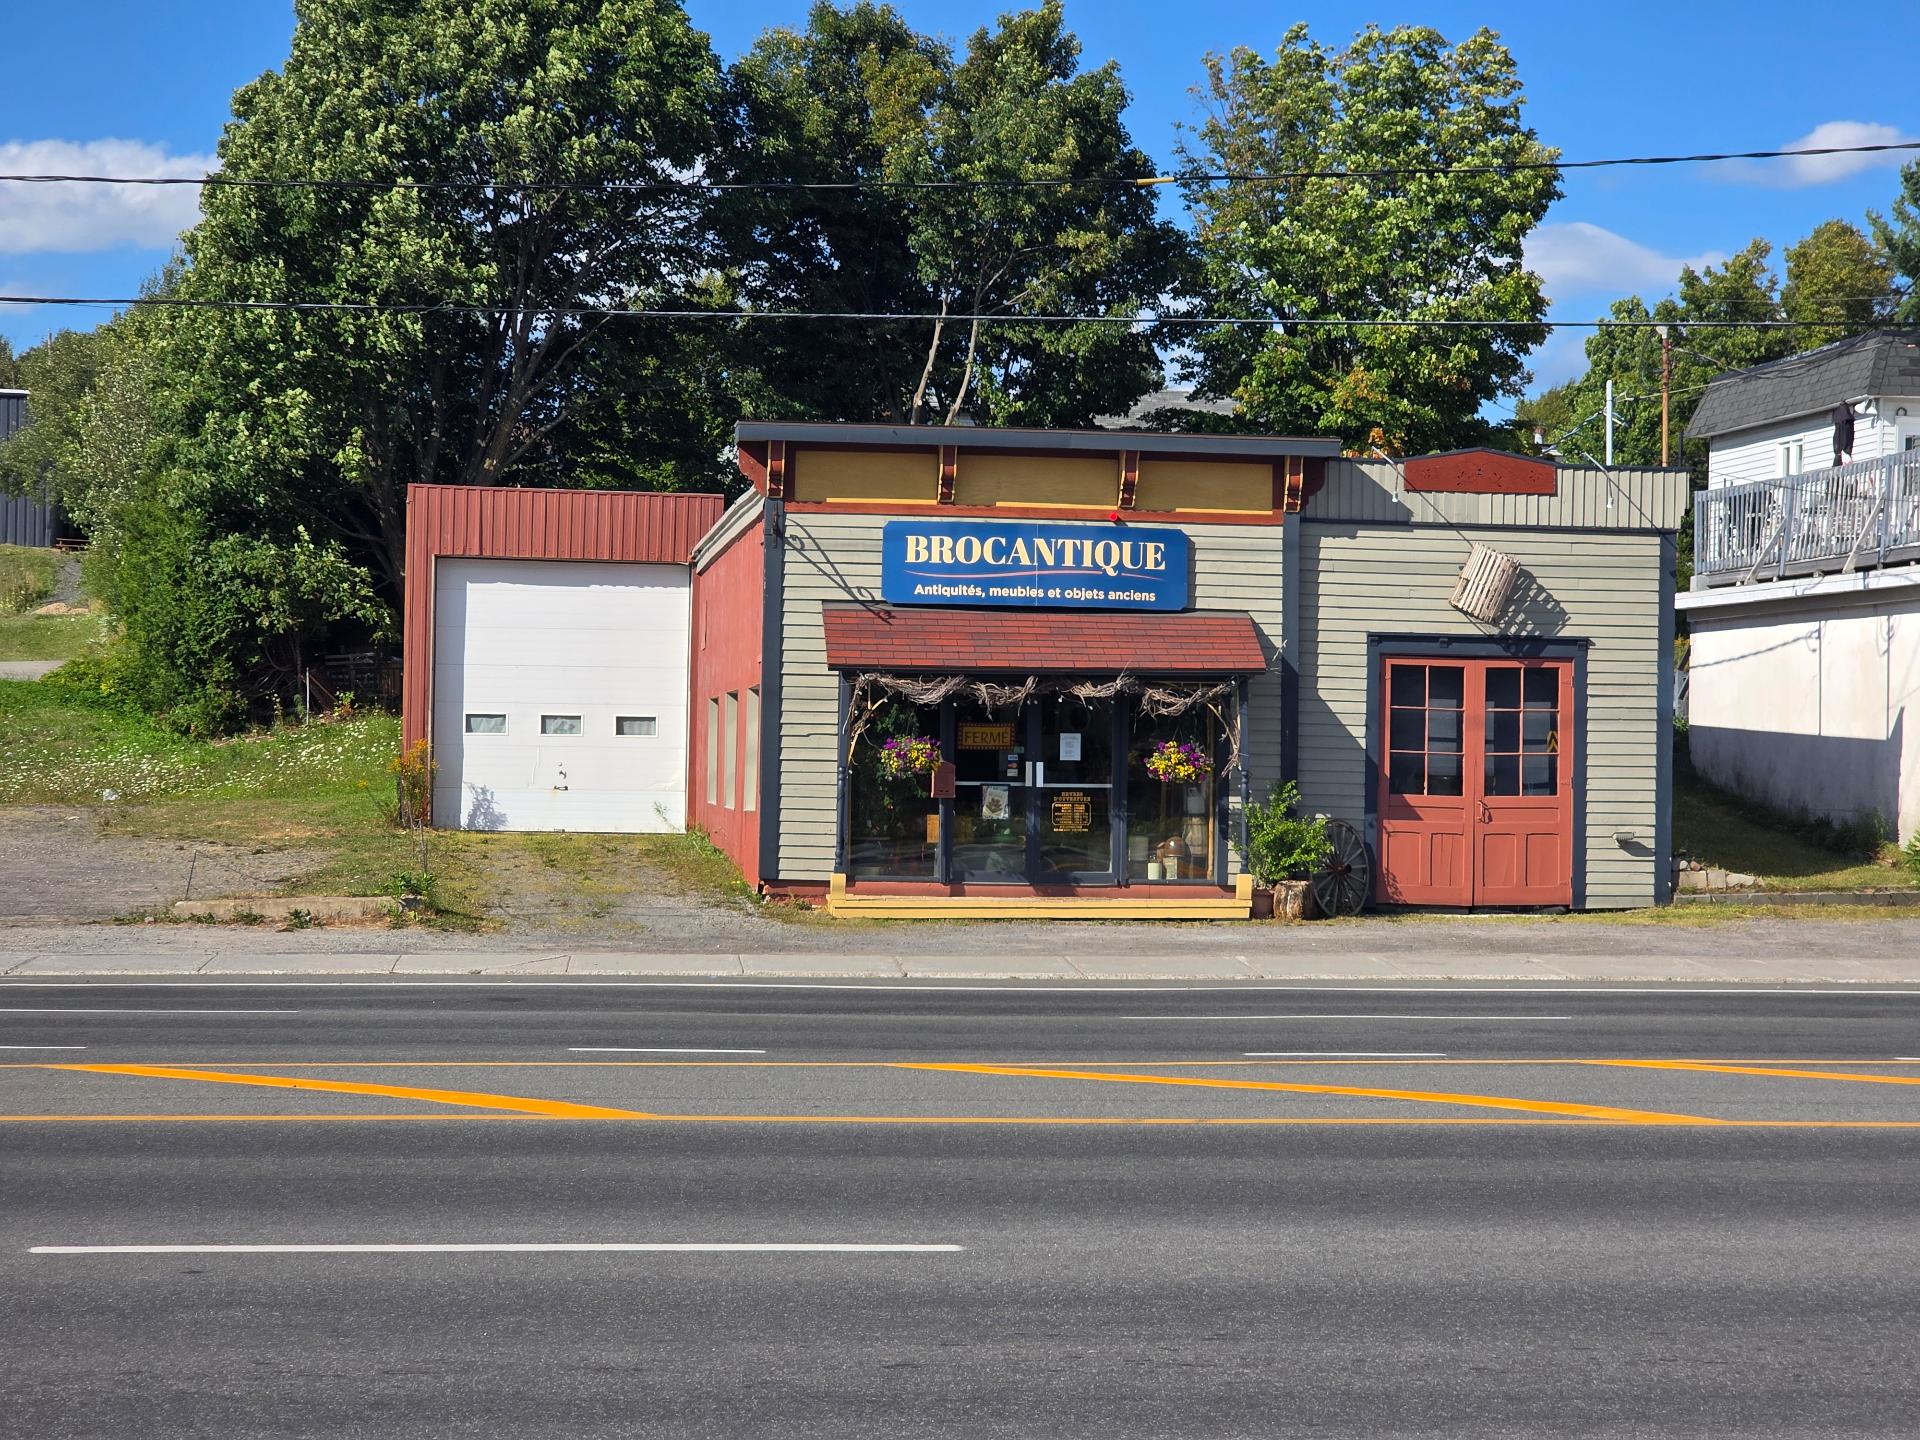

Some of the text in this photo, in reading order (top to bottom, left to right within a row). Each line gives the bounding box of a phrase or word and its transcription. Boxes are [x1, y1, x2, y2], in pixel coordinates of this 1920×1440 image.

[905, 536, 1165, 576] BROCANTIQUE
[914, 584, 1156, 601] Antiquités, meubles et objets anciens
